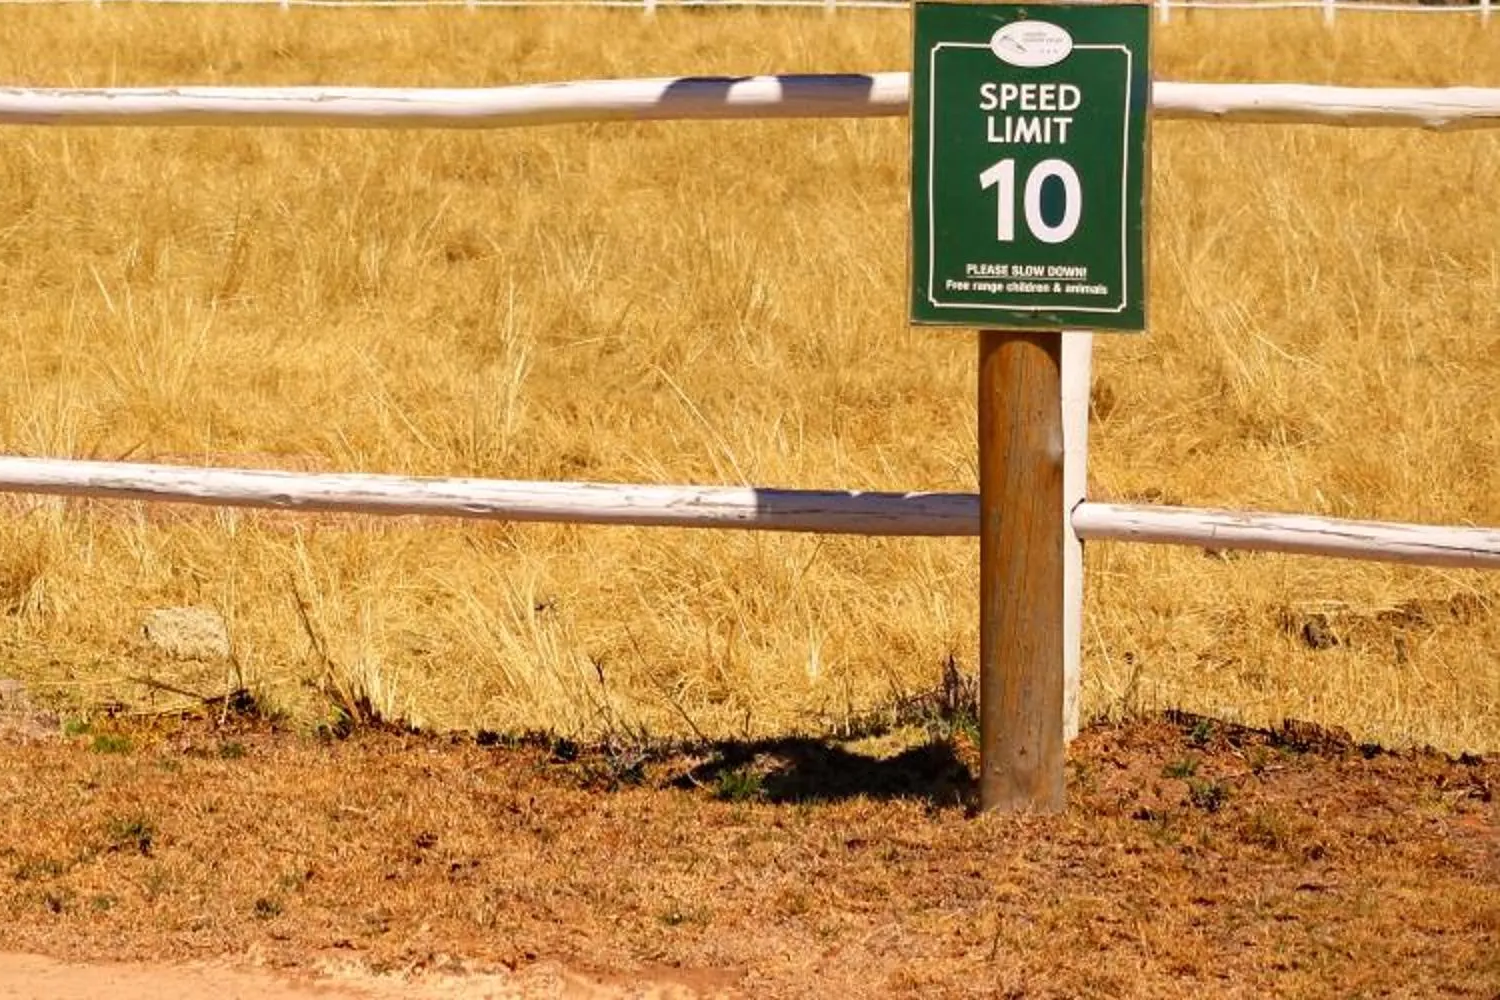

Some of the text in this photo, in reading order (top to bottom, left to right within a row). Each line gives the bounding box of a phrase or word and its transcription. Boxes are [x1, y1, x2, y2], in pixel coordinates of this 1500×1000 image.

[979, 82, 1081, 111] SPEED
[987, 116, 1072, 144] LIMIT
[979, 158, 1083, 244] 10
[966, 263, 1088, 278] PLEASE SLOW DOWN!
[945, 279, 1109, 295] Free range children & animals
